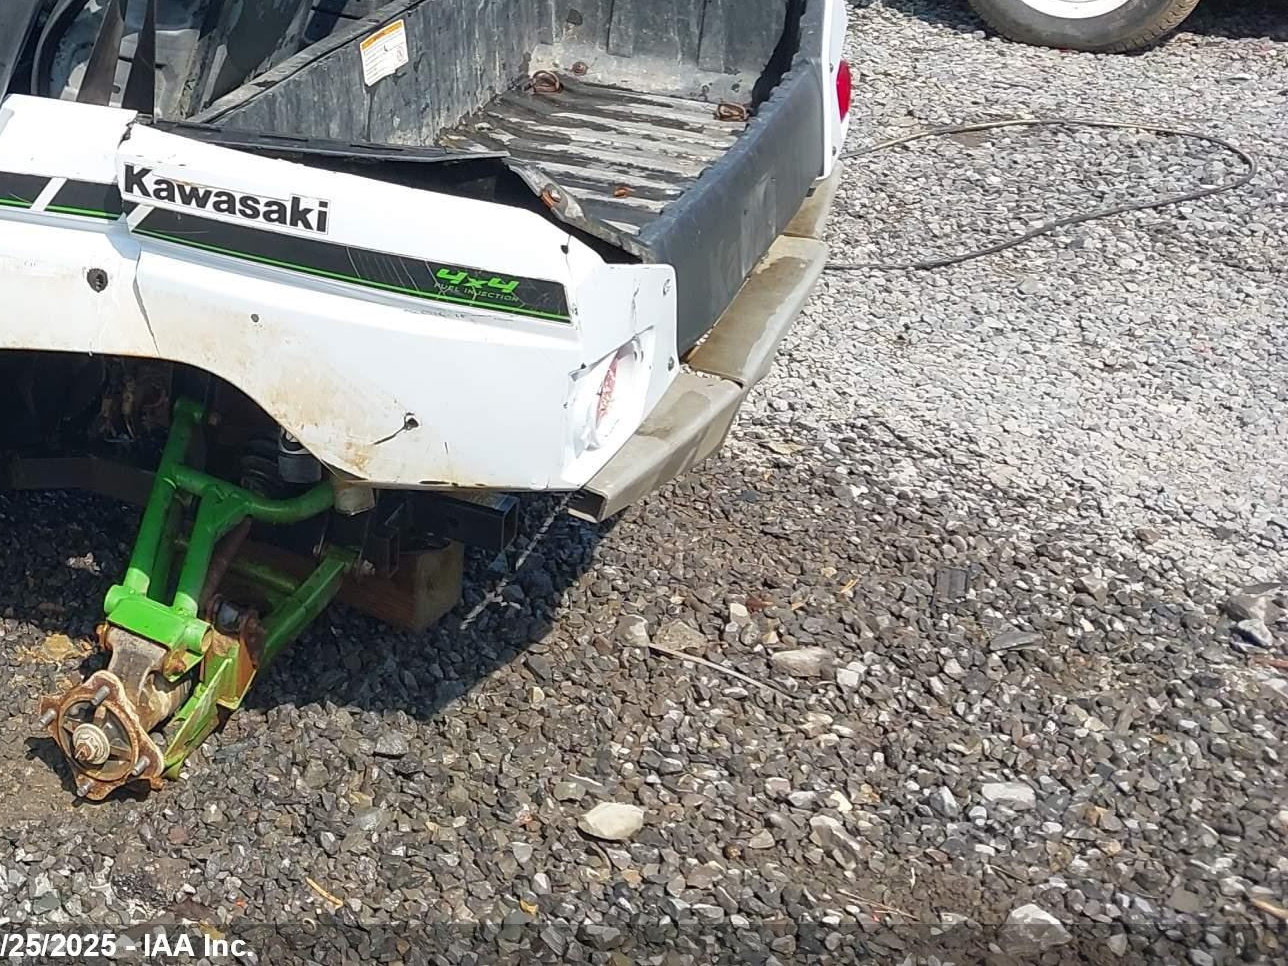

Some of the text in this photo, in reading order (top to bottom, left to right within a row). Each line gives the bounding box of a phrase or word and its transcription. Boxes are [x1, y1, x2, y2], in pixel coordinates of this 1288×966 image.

[124, 164, 329, 233] Kawasaki
[434, 283, 520, 303] FUEL INJECTION
[436, 268, 520, 293] 4x4
